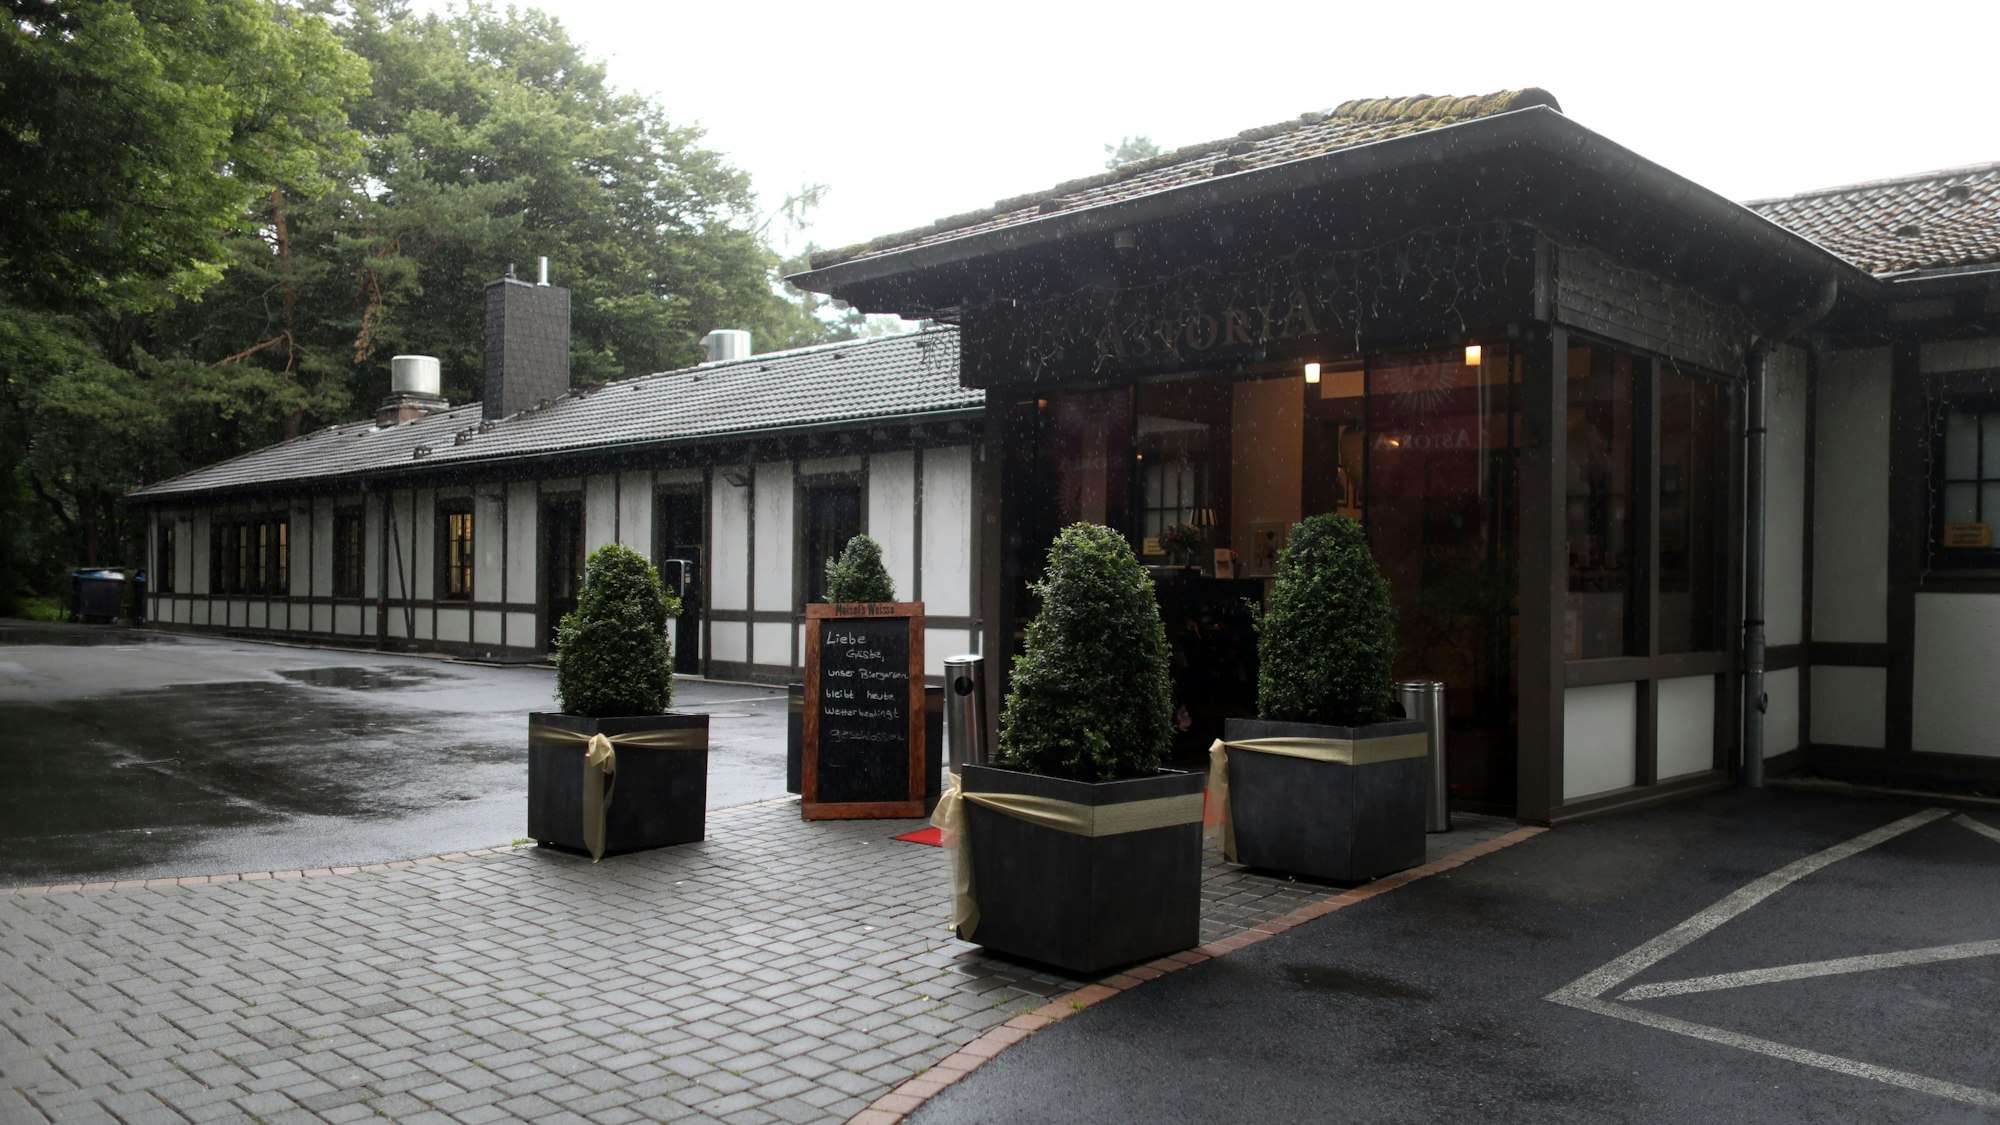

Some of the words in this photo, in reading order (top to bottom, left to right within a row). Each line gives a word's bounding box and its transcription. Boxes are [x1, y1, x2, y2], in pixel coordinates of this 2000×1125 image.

[1097, 272, 1320, 357] ASTORIA
[867, 602, 895, 615] Weisse
[826, 631, 866, 645] Liebe
[845, 649, 885, 662] Gäste,
[828, 669, 855, 678] unser
[859, 668, 909, 681] Biergarten
[826, 689, 854, 699] bleibt
[866, 690, 895, 701] heute
